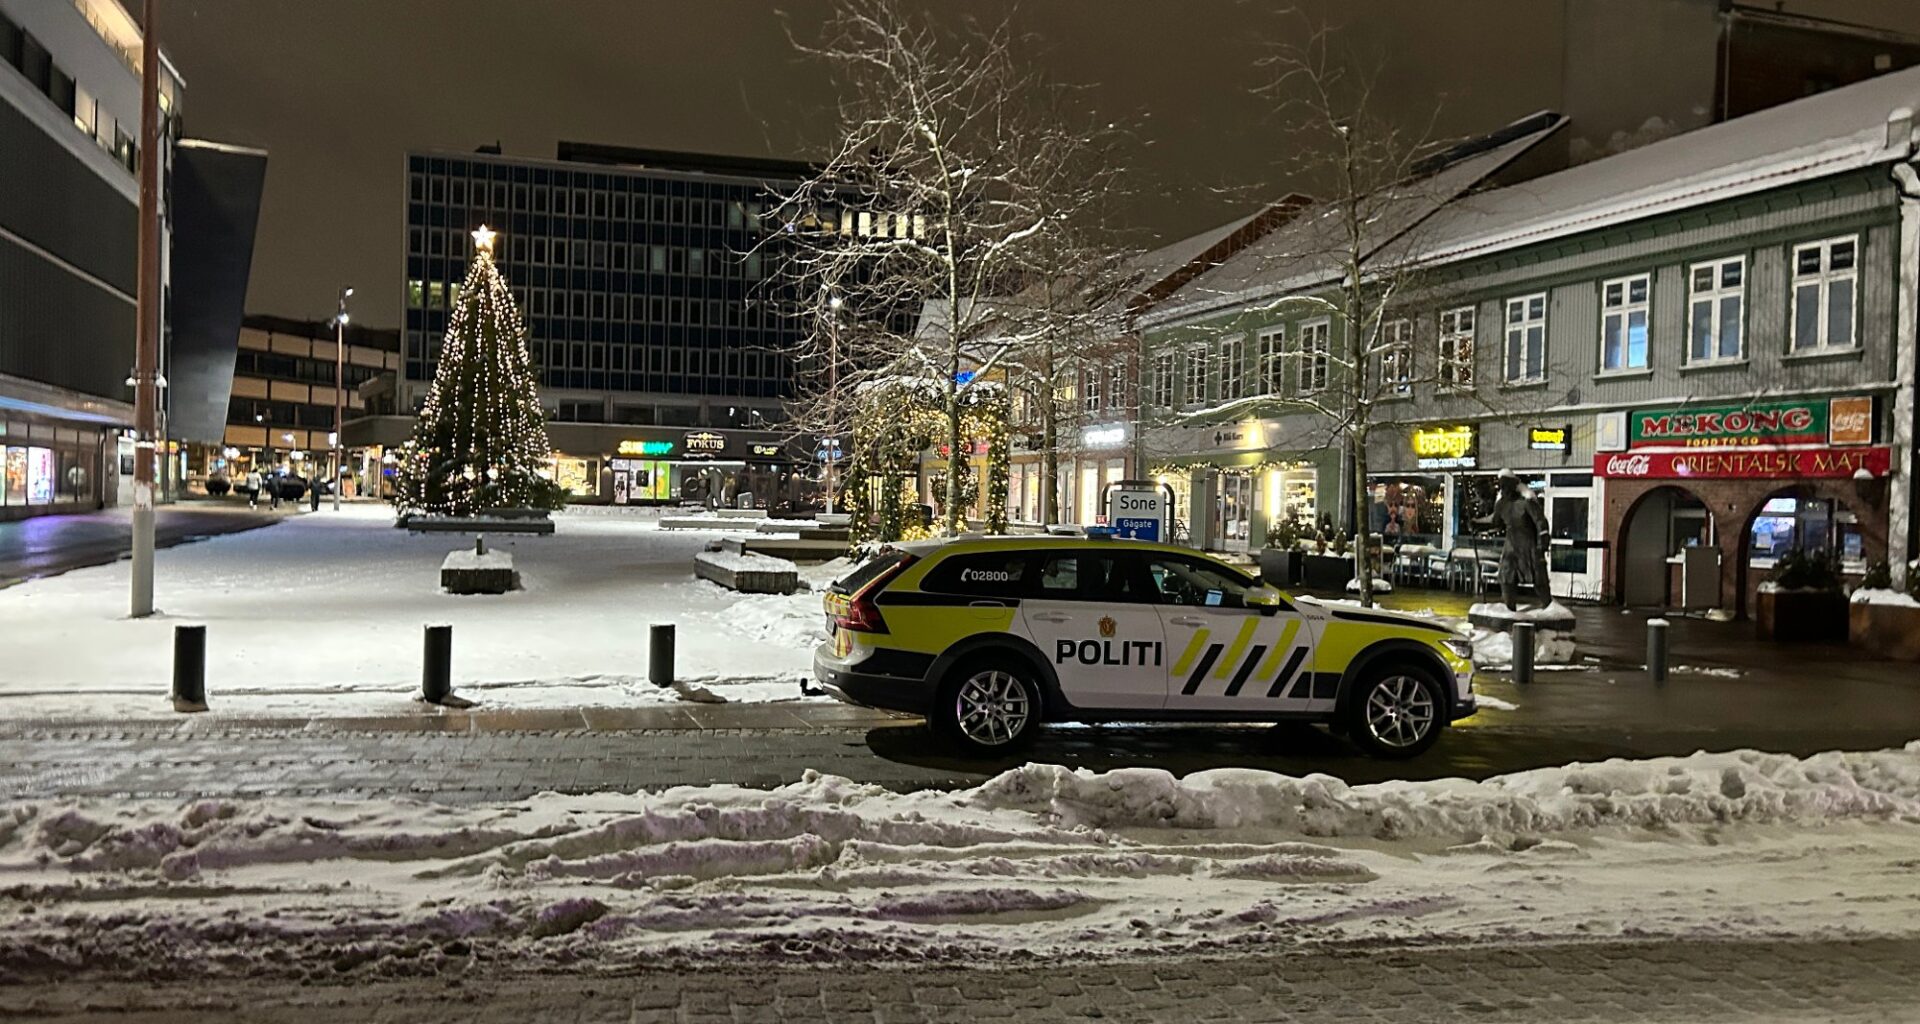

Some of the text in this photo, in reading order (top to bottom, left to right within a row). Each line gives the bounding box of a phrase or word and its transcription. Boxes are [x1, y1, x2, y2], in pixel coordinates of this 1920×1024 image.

[1641, 408, 1813, 436] MEKONG
[686, 439, 724, 449] FOKUS
[1417, 426, 1473, 458] babaji
[1687, 436, 1758, 447] FOOD TO GO
[1671, 452, 1871, 473] ORIENTALSK MAT
[1120, 495, 1157, 510] Sone
[1123, 519, 1152, 529] Gågate
[971, 570, 1008, 581] 02800
[1056, 639, 1162, 666] POLITI
